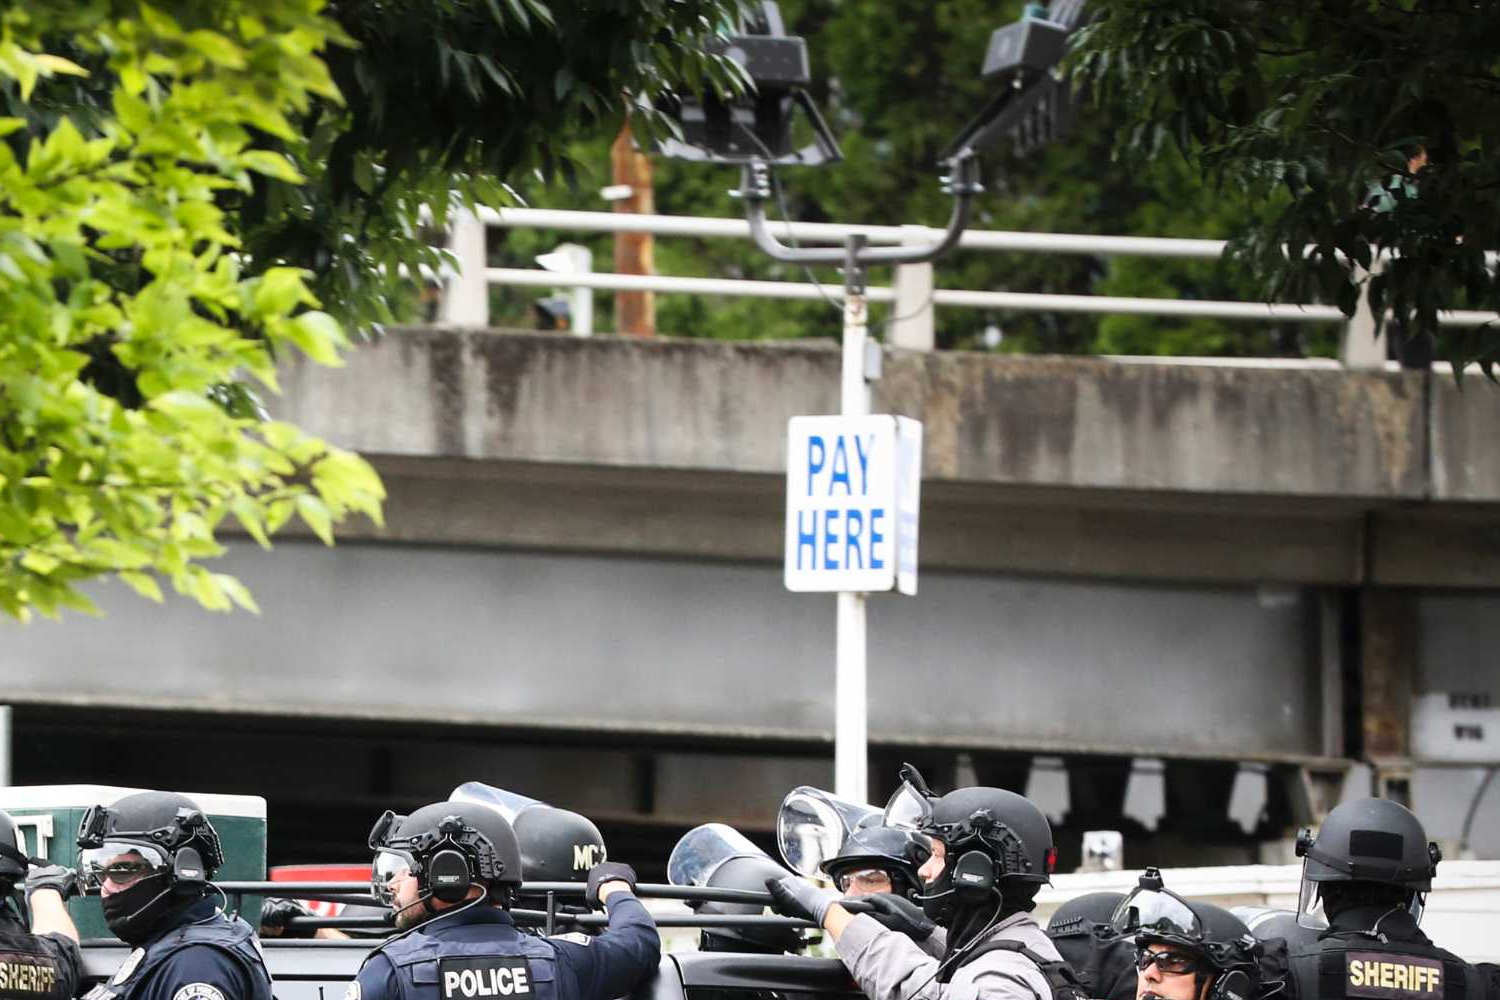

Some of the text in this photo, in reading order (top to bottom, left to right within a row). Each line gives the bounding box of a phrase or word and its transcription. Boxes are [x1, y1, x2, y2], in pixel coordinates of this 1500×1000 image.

[808, 435, 875, 496] PAY
[797, 509, 884, 570] HERE
[444, 967, 530, 998] POLICE
[1349, 959, 1440, 993] SHERIFF
